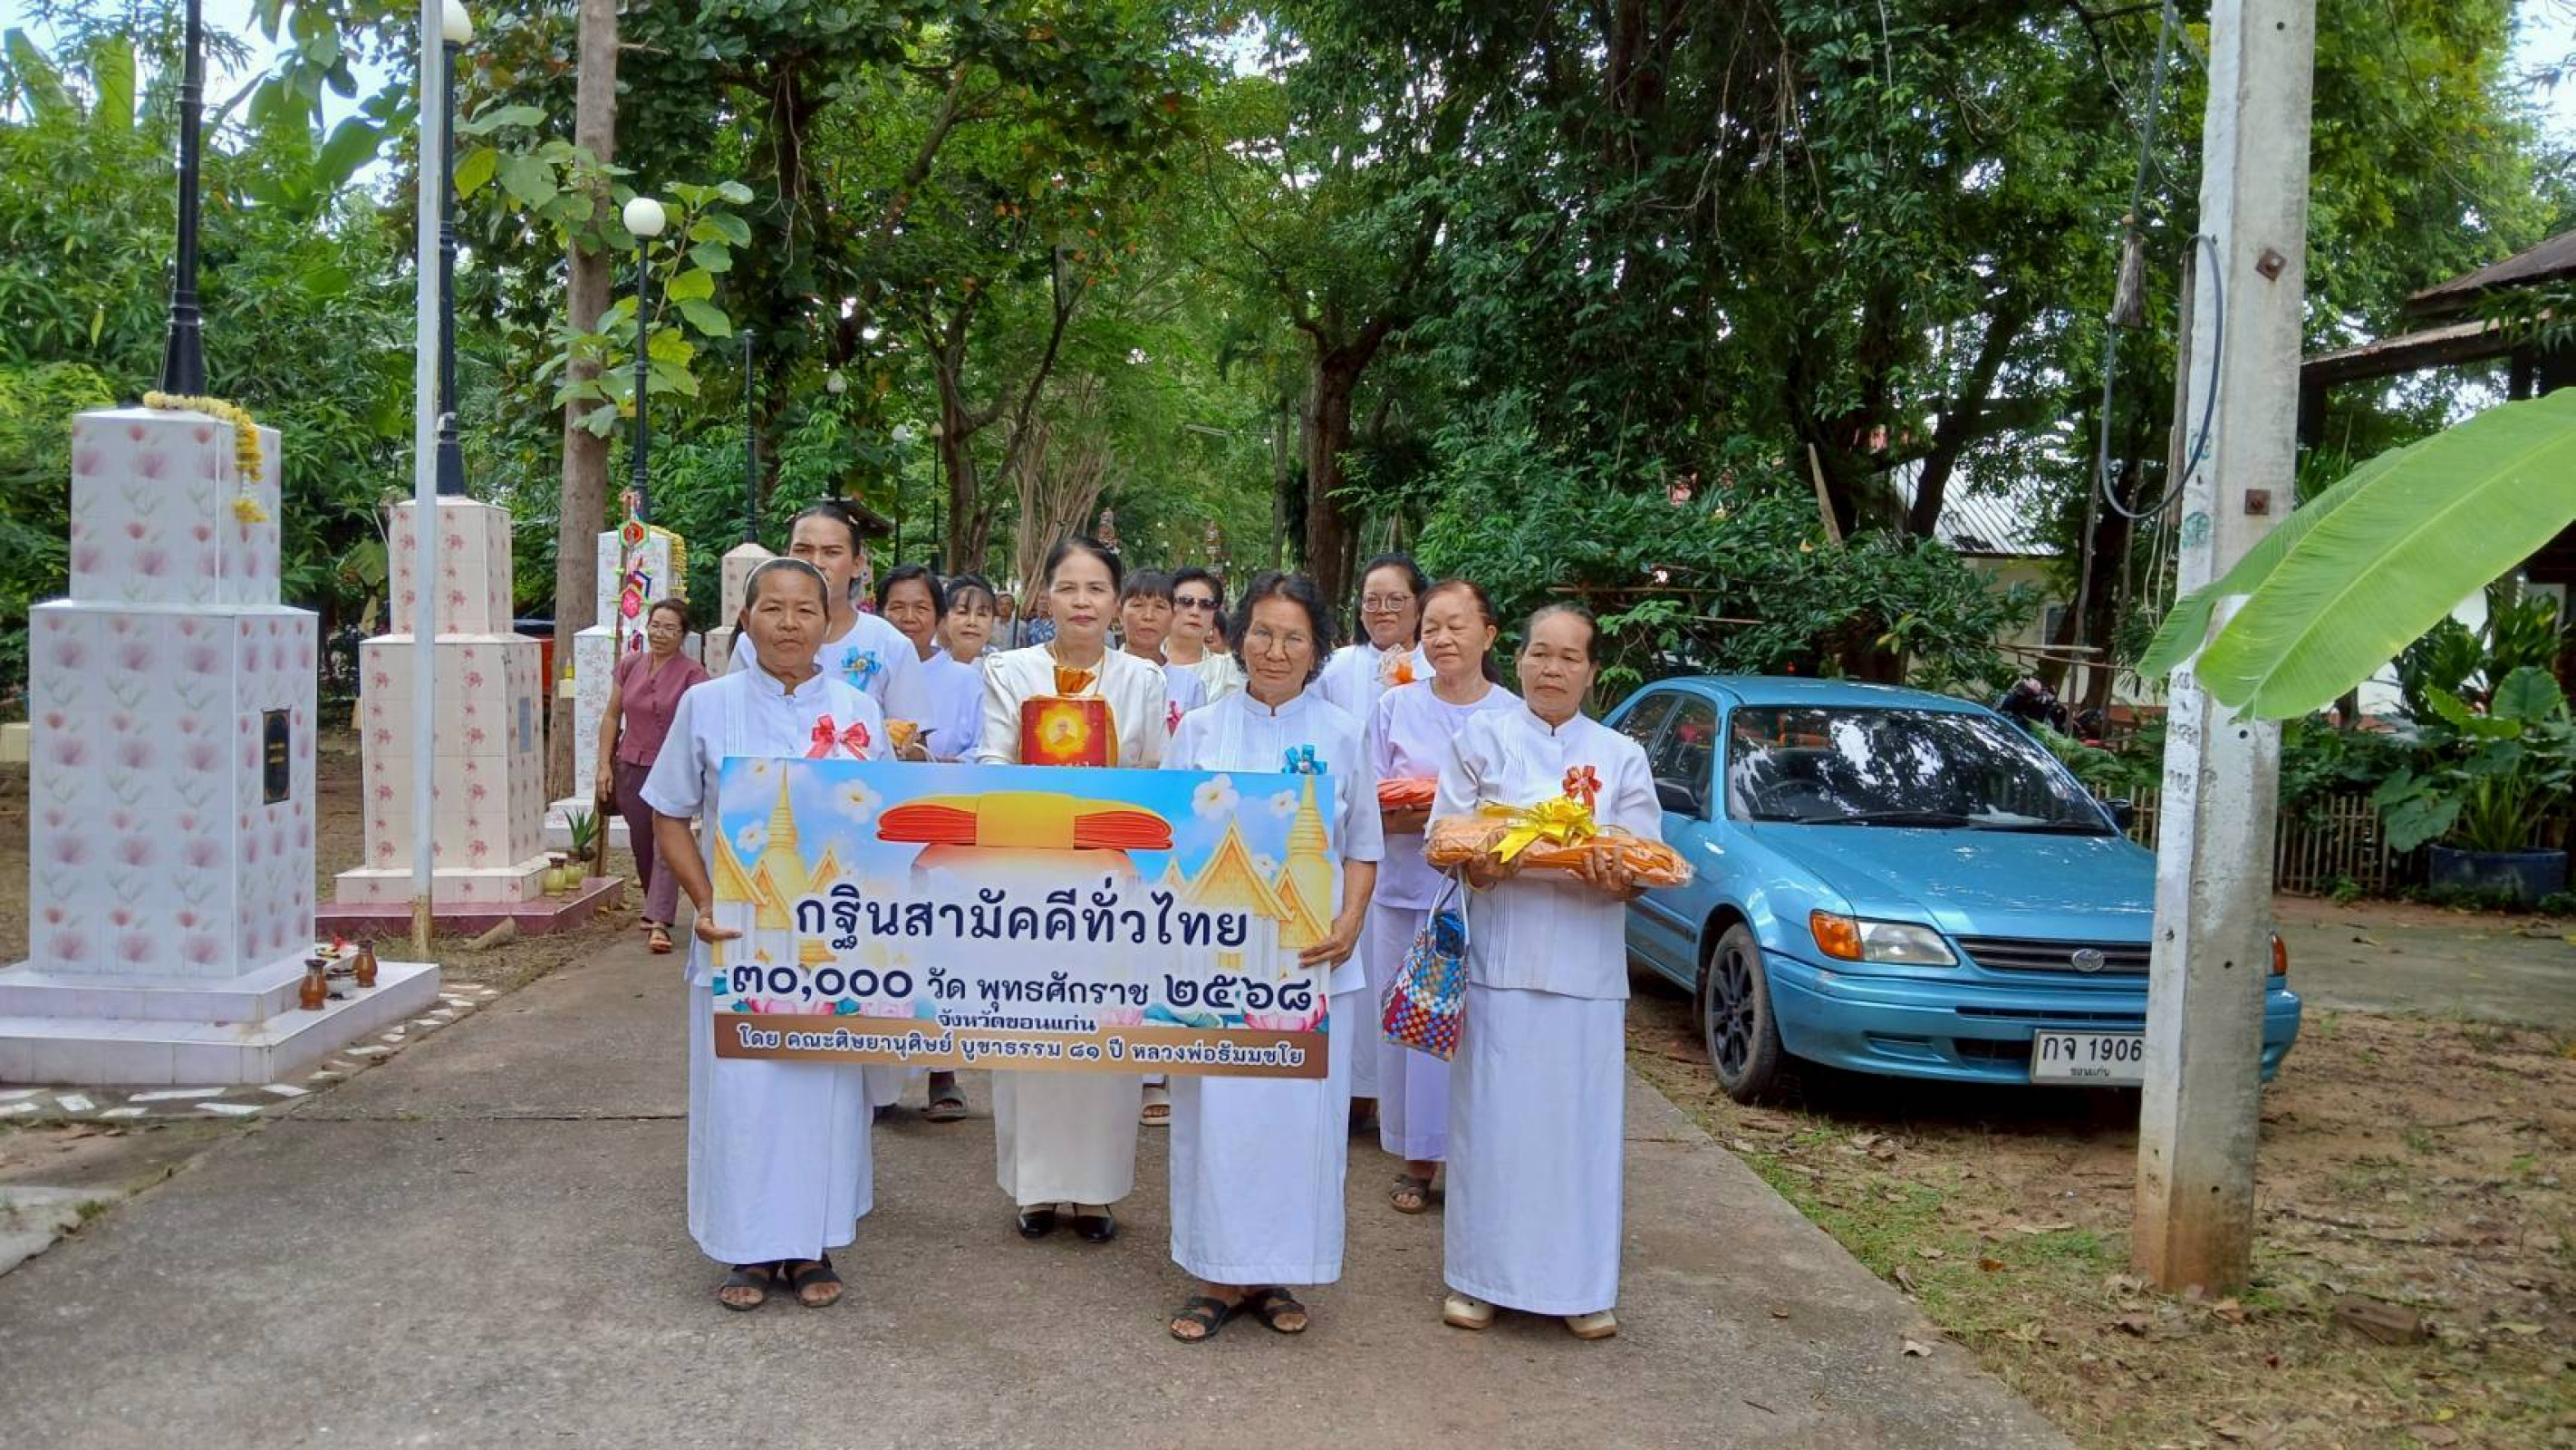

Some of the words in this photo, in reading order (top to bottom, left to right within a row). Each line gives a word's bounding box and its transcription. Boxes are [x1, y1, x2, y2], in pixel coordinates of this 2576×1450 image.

[796, 876, 1248, 950] กฐินสามัคคีทั่วไทย
[732, 964, 913, 1001] ๓๐,๐๐๐
[927, 966, 966, 1000] วัด
[977, 972, 1149, 1012] พุทธศักราช
[1163, 973, 1312, 1010] ๒๕๖๘
[938, 1008, 1097, 1031] จังหวัดขอนแก่น
[739, 1026, 777, 1047] โดย
[787, 1029, 952, 1057] คณะศิษยานุศิษย์
[961, 1039, 1061, 1060] บูชาธรรม
[1109, 1039, 1123, 1058] ปี
[2042, 1037, 2077, 1060] กจ
[2089, 1038, 2143, 1061] 1906
